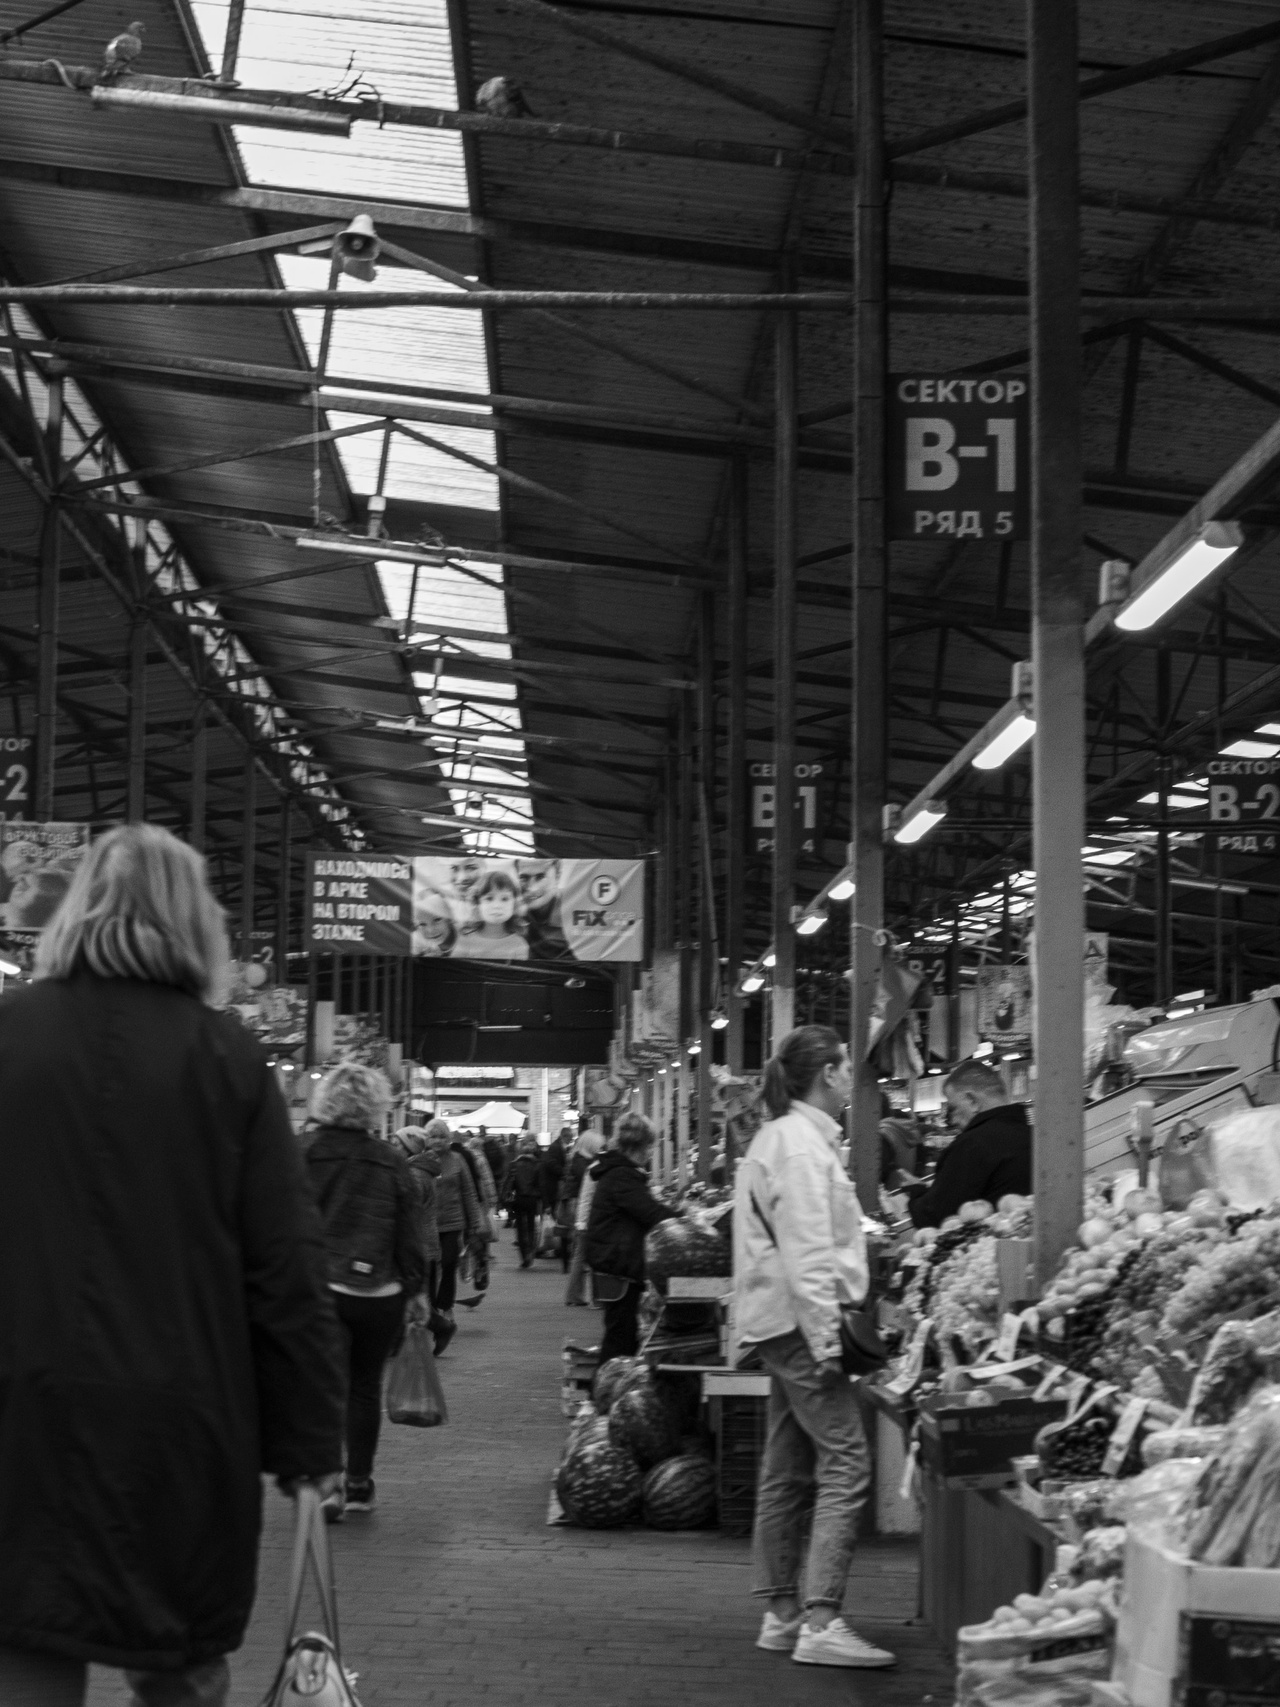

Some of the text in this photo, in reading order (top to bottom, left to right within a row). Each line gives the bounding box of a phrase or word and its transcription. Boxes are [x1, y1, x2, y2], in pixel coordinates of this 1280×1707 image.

[898, 379, 1027, 403] СЕКТОР
[906, 417, 1016, 492] В-1
[914, 511, 1014, 539] РЯД 5
[749, 763, 823, 778] СЕОР
[1207, 760, 1280, 775] СЕКТОР
[801, 839, 815, 852] 4
[1217, 836, 1276, 853] РЯД 4
[314, 860, 410, 879] НАХОДИМСЯ
[313, 881, 369, 899] В АРКЕ
[598, 883, 611, 898] F
[313, 903, 401, 921] НА ВТОРОМ
[312, 924, 365, 941] ЭТАЖЕ
